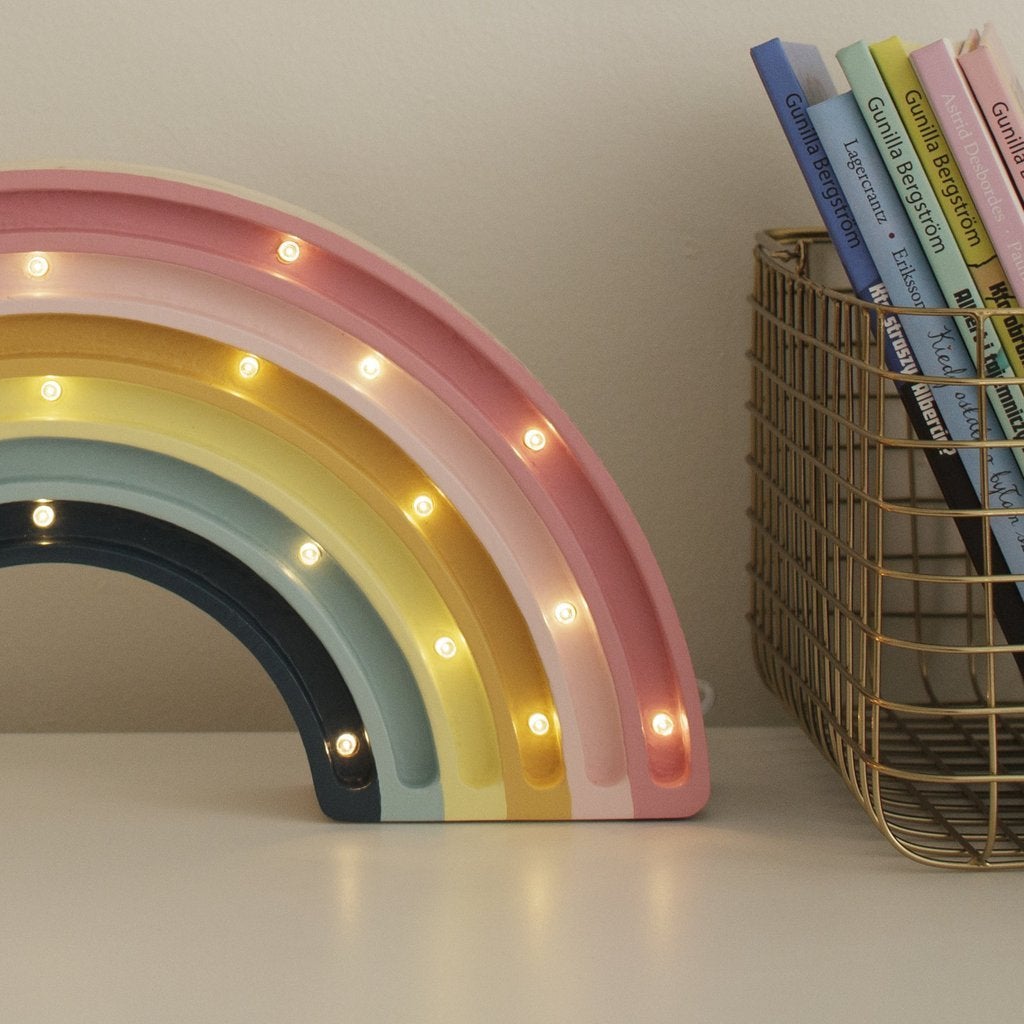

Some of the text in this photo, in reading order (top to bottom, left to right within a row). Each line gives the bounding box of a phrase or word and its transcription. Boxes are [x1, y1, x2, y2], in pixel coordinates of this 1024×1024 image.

[785, 93, 861, 249] Gunilla Bergström
[843, 138, 888, 225] Lagercrantz
[868, 96, 946, 254] Gunilla Bergström
[905, 89, 981, 247] Gunilla Bergström
[942, 94, 973, 140] Astrid
[964, 141, 1005, 223] Desbordes
[992, 102, 1024, 164] Gunilla
[911, 383, 956, 455] Alberci?
[953, 288, 988, 342] Alert
[983, 353, 1024, 441] tajmniczy
